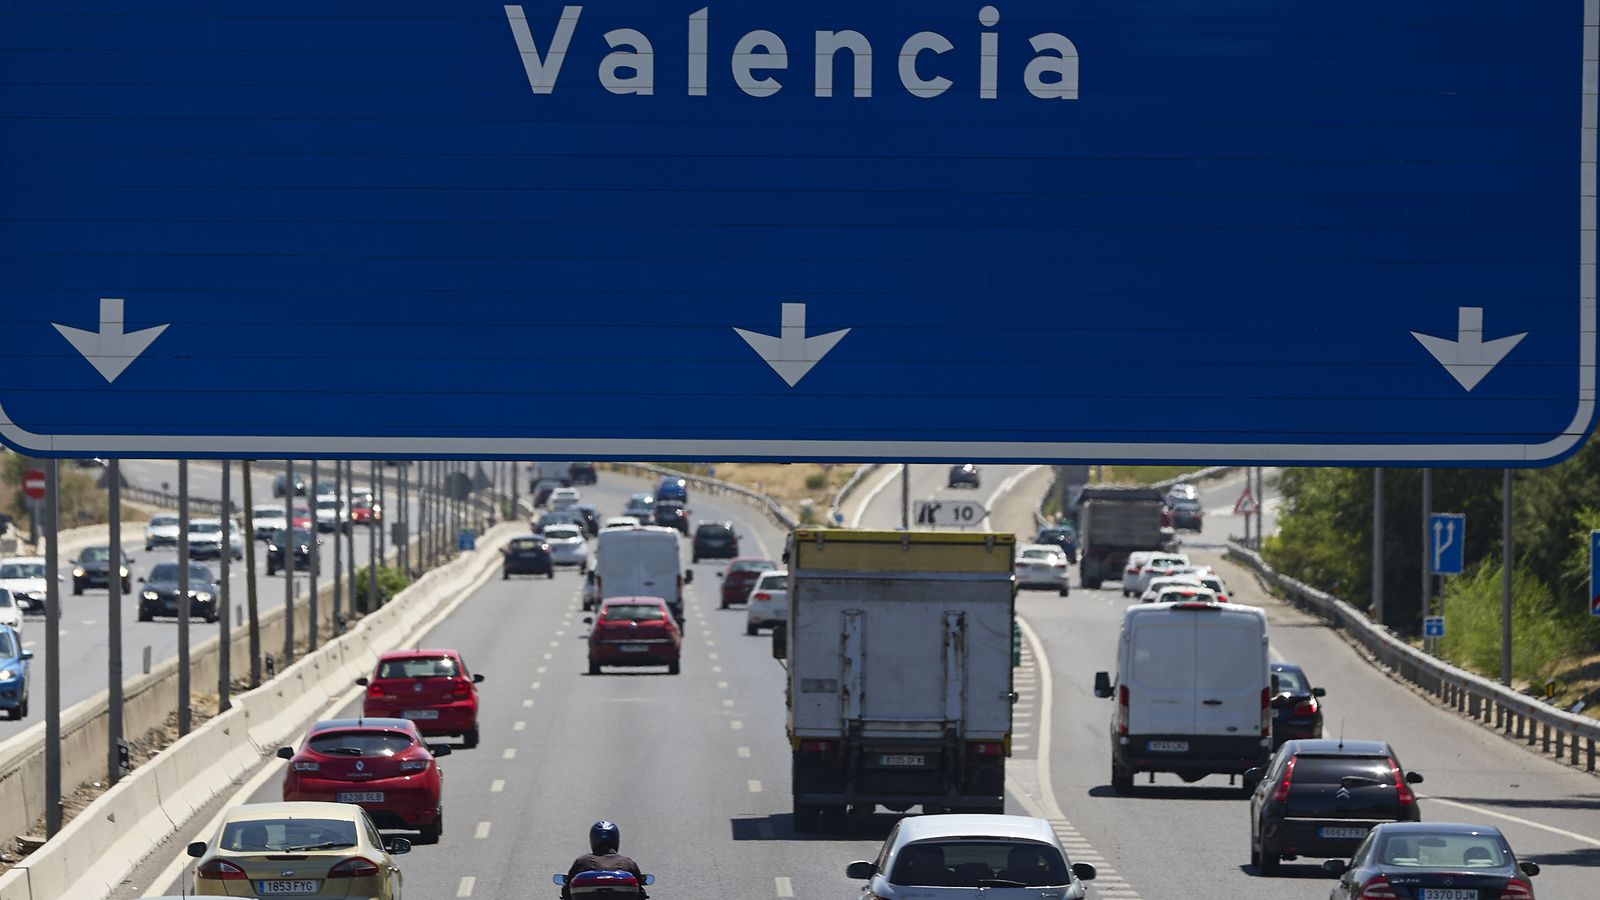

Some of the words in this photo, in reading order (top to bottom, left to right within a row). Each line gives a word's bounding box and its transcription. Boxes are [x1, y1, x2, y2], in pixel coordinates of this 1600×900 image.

[504, 5, 1080, 100] Valencia
[953, 506, 973, 521] 10
[267, 881, 291, 892] 1853
[293, 881, 312, 892] FYG
[1426, 890, 1452, 900] 3370
[1455, 891, 1475, 900] DJM
